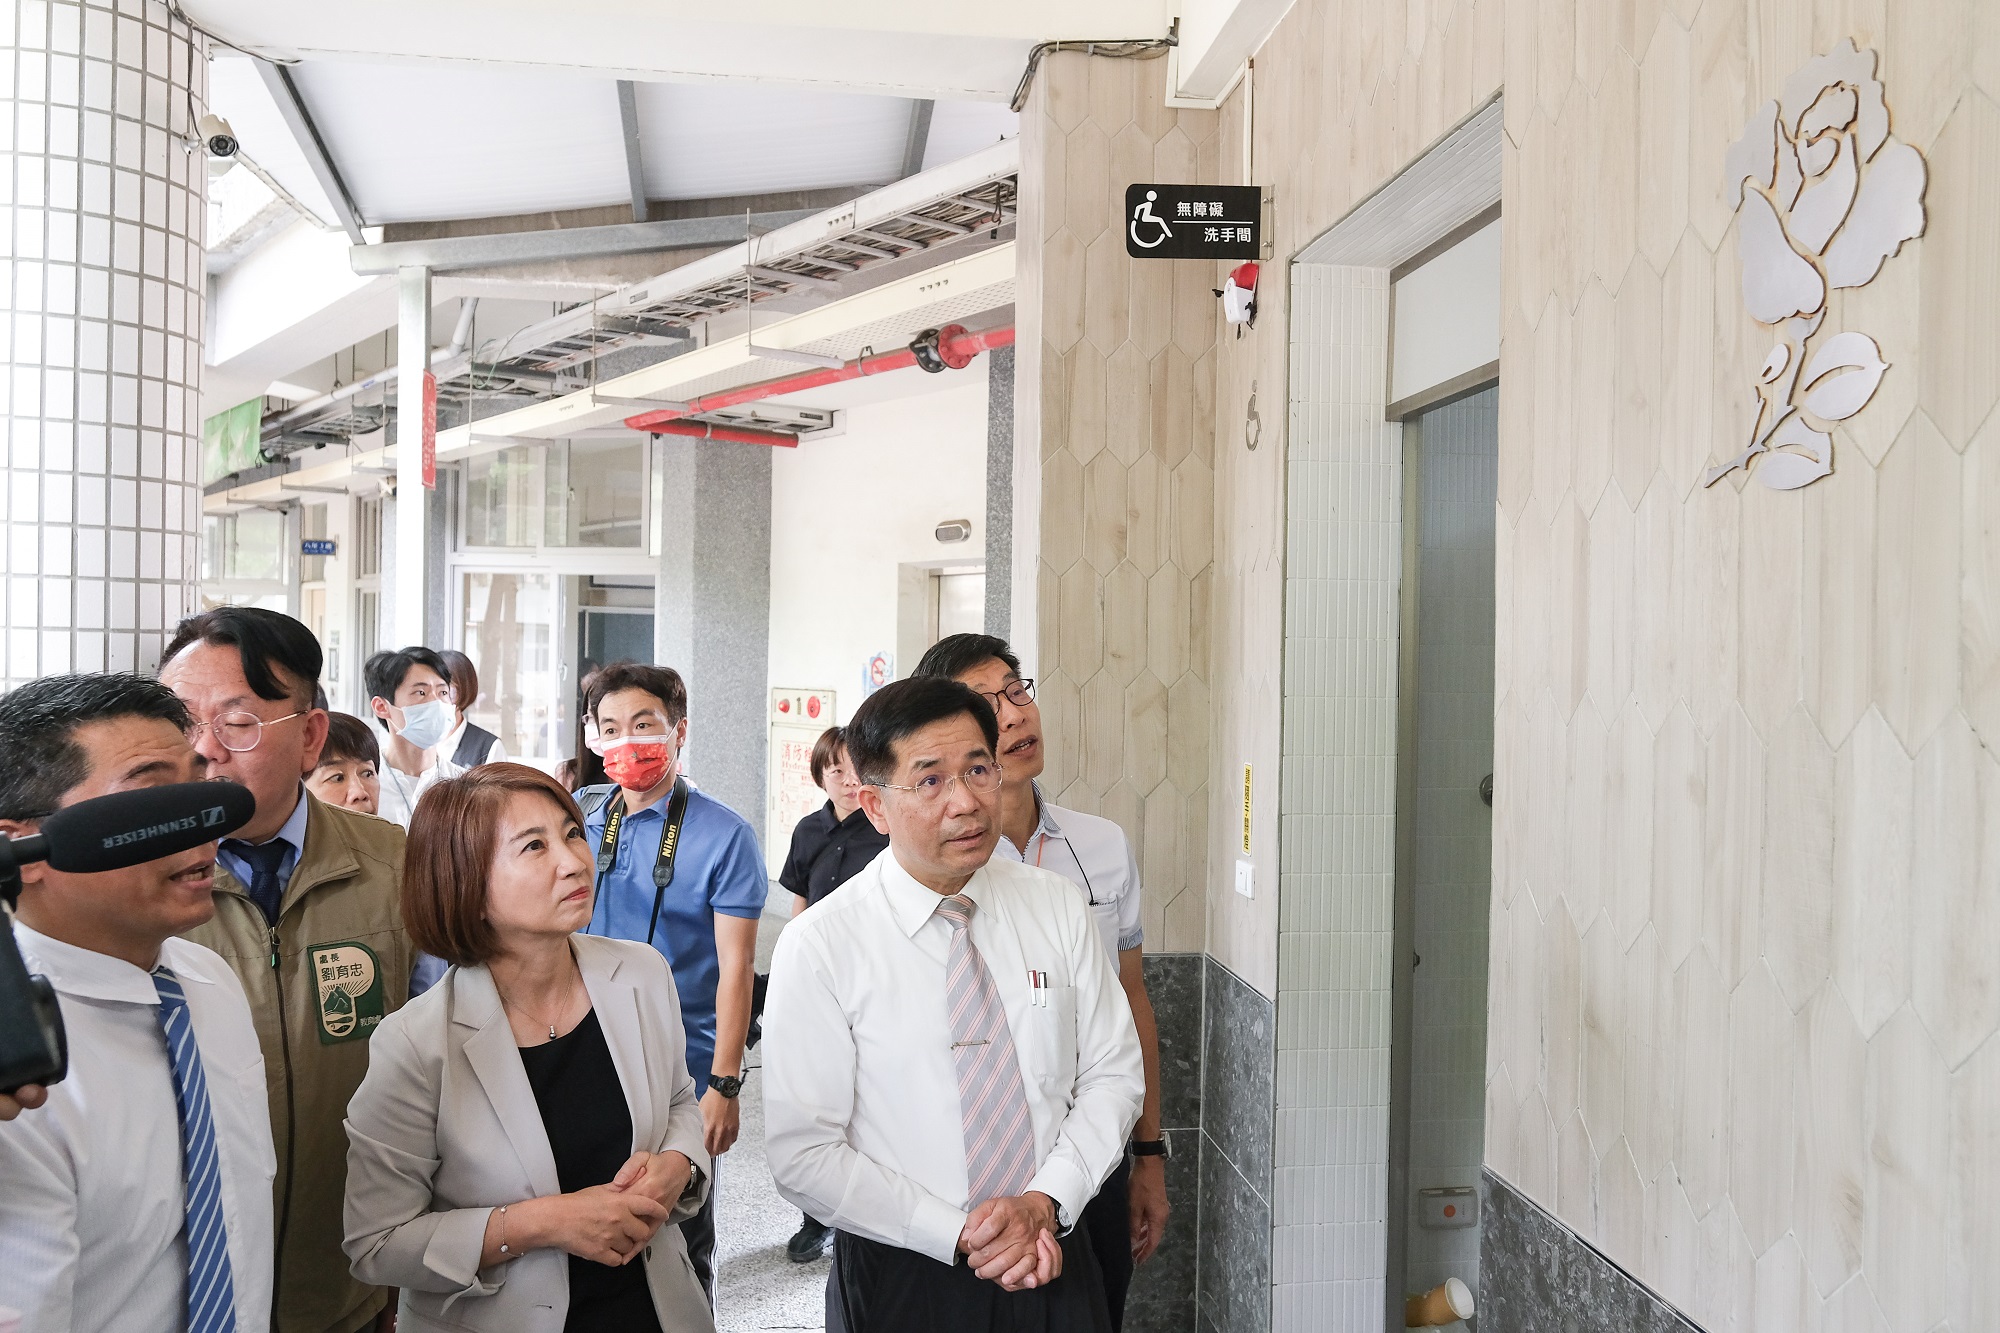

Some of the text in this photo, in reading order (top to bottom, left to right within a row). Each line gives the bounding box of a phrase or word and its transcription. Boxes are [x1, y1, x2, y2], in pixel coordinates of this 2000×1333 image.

[1177, 201, 1224, 218] 無障礙
[1204, 227, 1251, 243] 洗手間
[102, 816, 197, 849] SENNHEISER
[605, 812, 619, 844] Nikon
[662, 824, 677, 858] Nikon
[319, 953, 340, 964] 處長
[321, 963, 364, 982] 劉育忠
